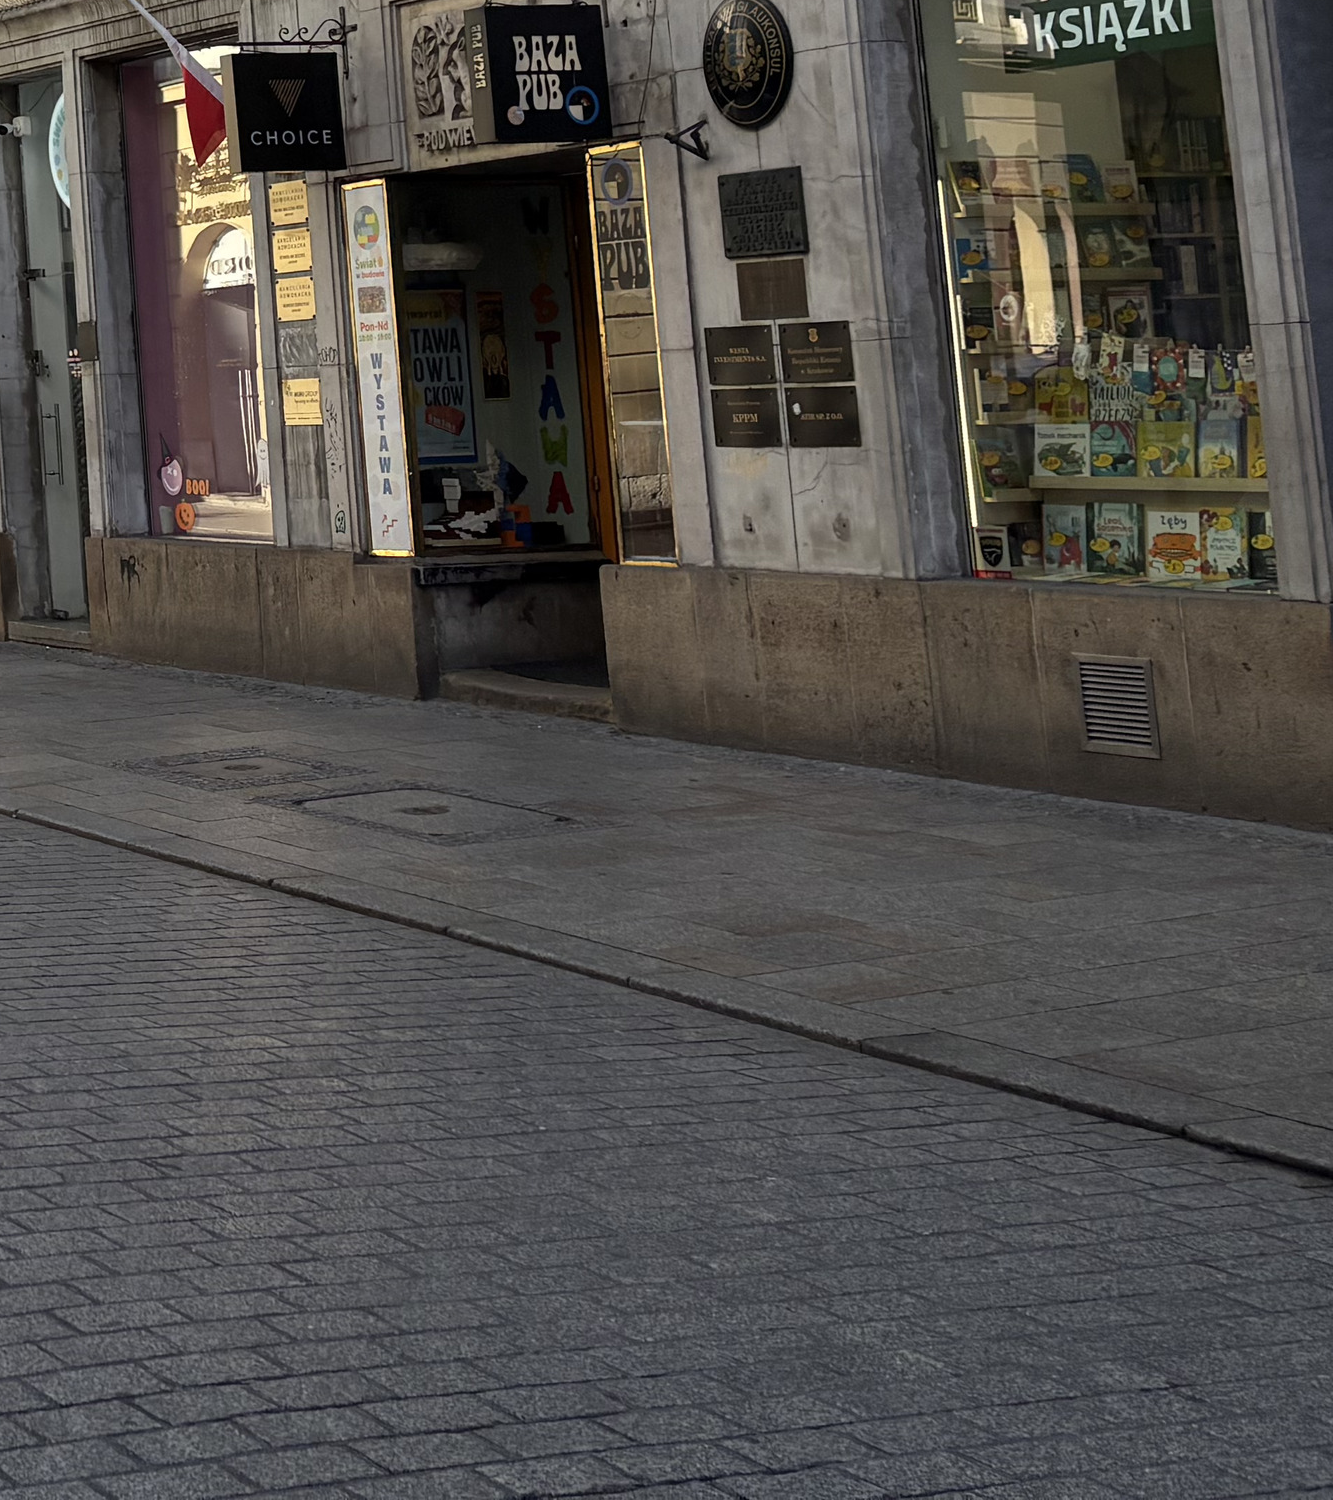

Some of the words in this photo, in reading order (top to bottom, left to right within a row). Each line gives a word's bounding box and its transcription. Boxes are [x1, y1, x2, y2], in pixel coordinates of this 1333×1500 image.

[471, 24, 483, 51] PUB
[749, 7, 782, 76] AUKONSUL
[513, 35, 582, 72] BAZA
[474, 53, 487, 89] BAZA
[516, 74, 563, 110] PUB
[250, 129, 333, 146] CHOICE
[598, 206, 646, 241] BAZA
[355, 257, 377, 270] Świat
[600, 240, 650, 291] PUB
[360, 321, 389, 332] Pon-Nd
[410, 328, 462, 355] TAWA
[370, 353, 393, 495] WYSTAWA
[732, 413, 758, 423] KPPM
[185, 479, 209, 496] BOO!
